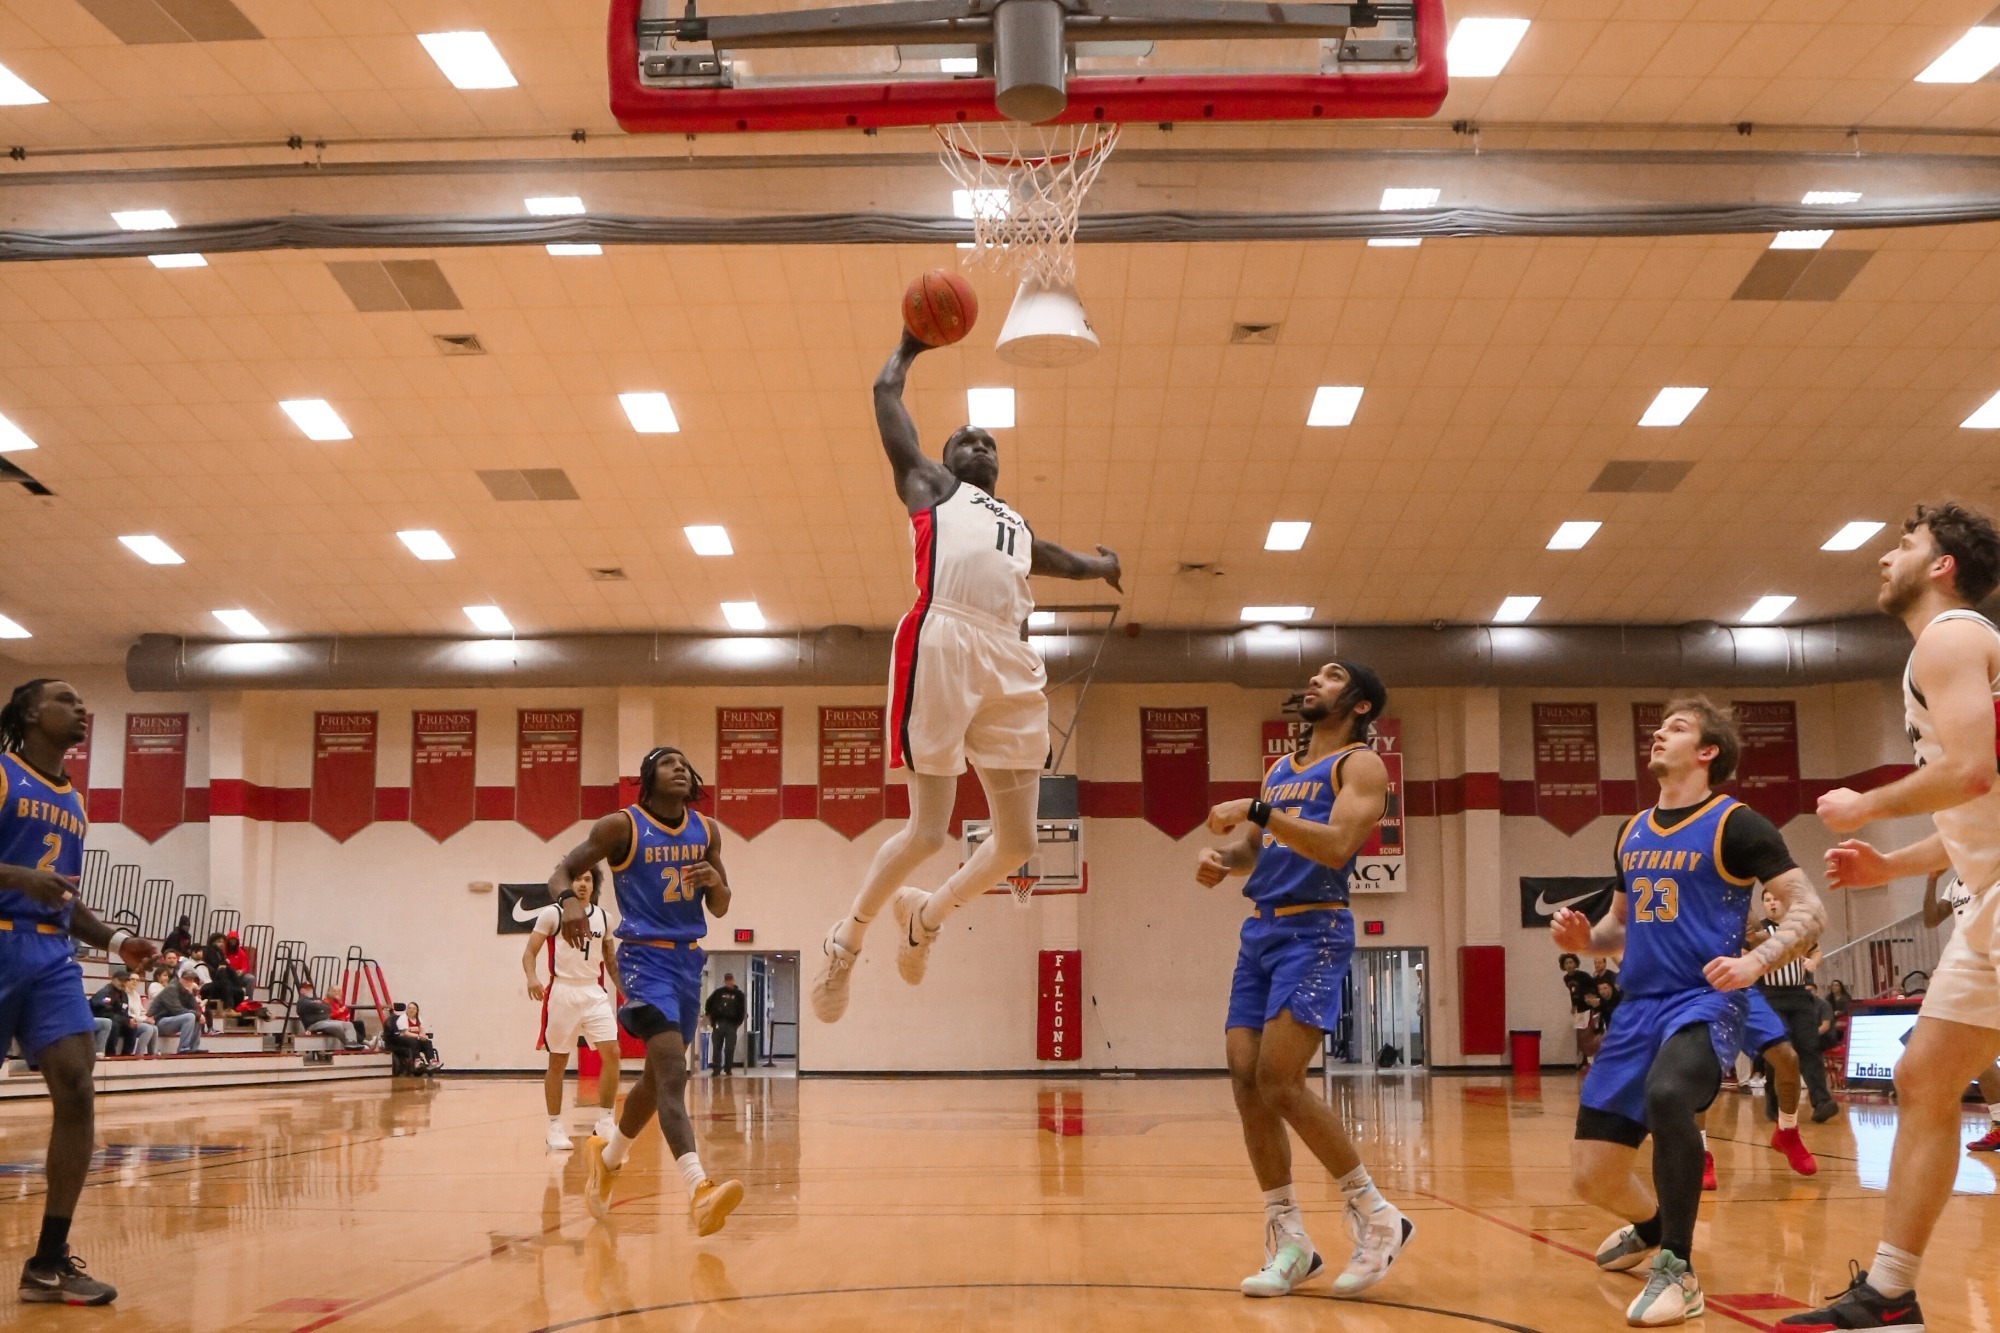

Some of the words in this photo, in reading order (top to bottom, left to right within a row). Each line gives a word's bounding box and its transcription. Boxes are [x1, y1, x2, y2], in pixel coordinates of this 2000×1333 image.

[996, 521, 1016, 557] 11
[524, 712, 576, 723] FRIENDS
[723, 710, 776, 722] FRIENDS
[825, 709, 879, 721] FRIENDS
[1146, 710, 1201, 721] FRIENDS
[1539, 705, 1591, 717] FRIENDS
[132, 716, 181, 727] FRIENDS
[321, 714, 372, 726] FRIENDS
[418, 713, 471, 725] FRIENDS
[17, 797, 84, 840] BETHANY
[36, 832, 62, 873] 2
[644, 844, 706, 864] BETHANY
[1379, 847, 1402, 855] SCORE
[1622, 850, 1703, 873] BETHANY
[1631, 876, 1679, 923] 23
[580, 940, 591, 961] 4
[1053, 954, 1065, 1058] FALCONS
[1855, 1062, 1892, 1078] Indian
